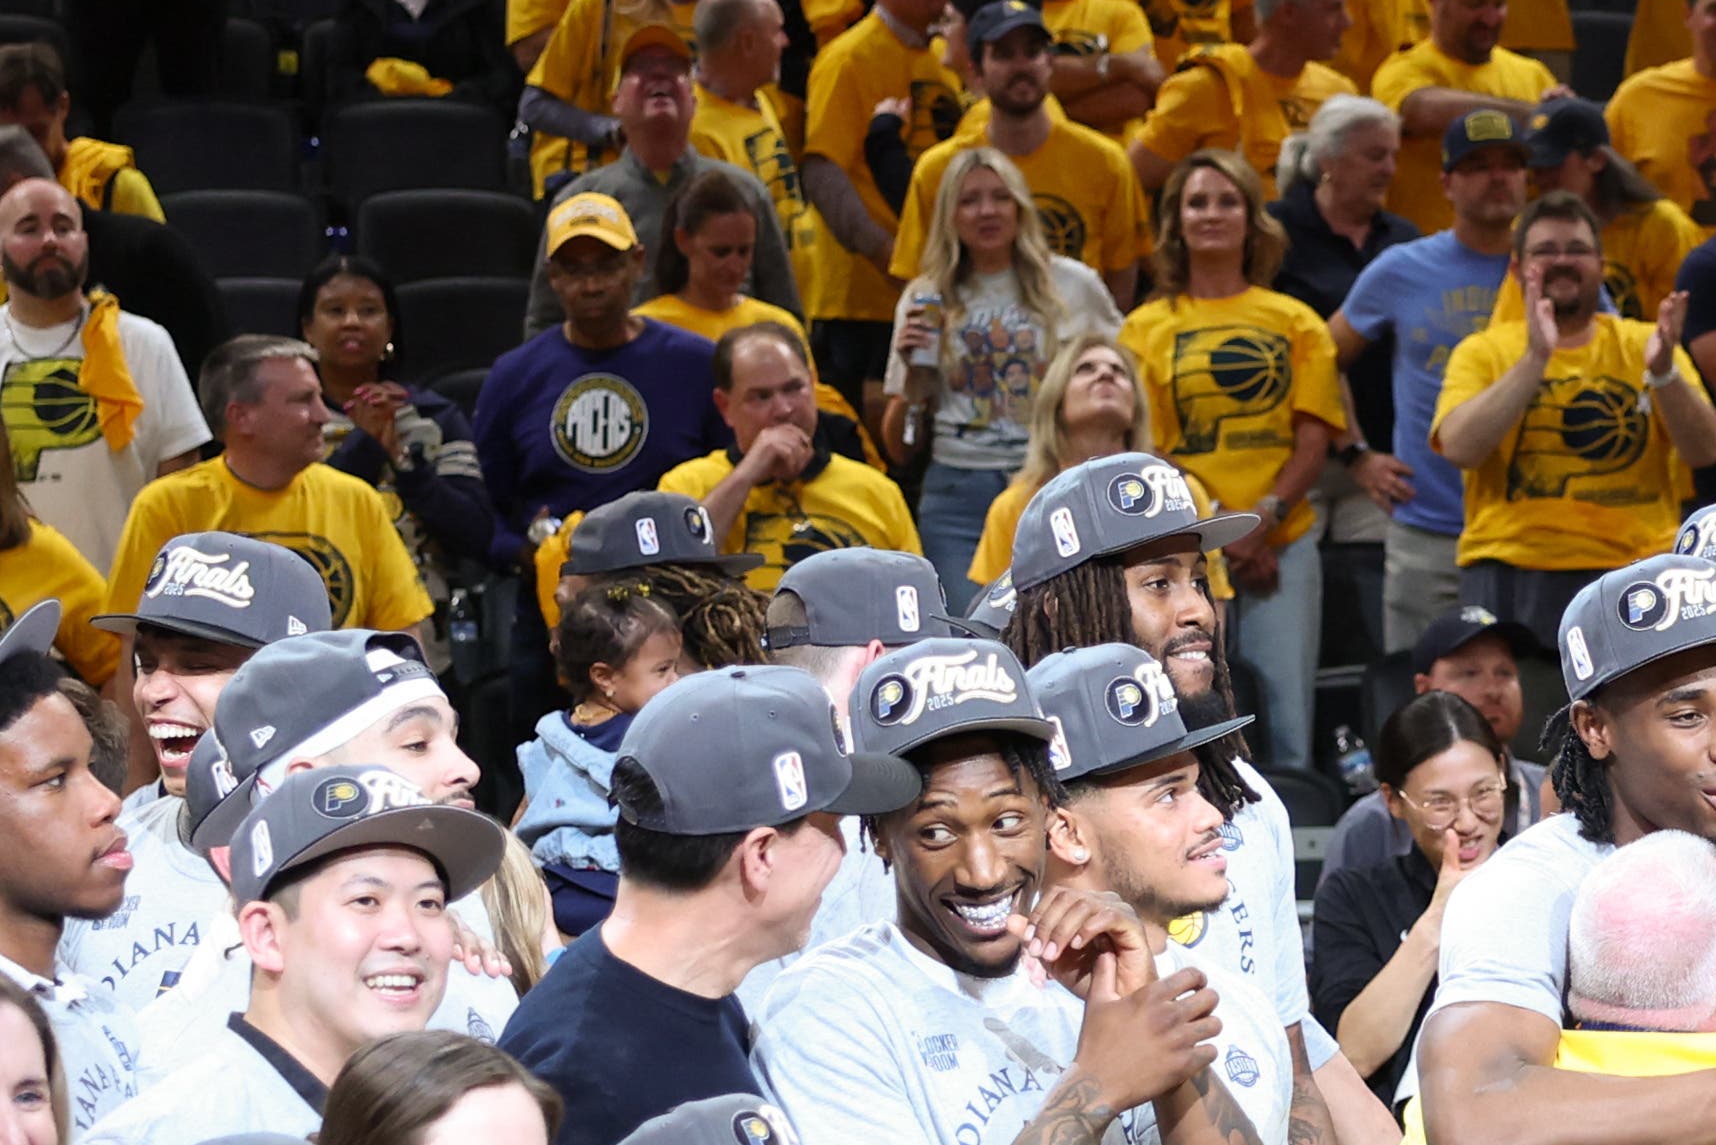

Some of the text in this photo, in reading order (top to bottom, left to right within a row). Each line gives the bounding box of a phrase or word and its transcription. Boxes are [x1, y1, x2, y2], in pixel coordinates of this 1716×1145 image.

[147, 545, 255, 599] Finals
[1680, 604, 1708, 620] 2025
[901, 649, 1016, 726] Finals
[927, 693, 955, 711] 2025
[101, 921, 202, 991] IANA
[954, 1066, 1044, 1145] DIANA
